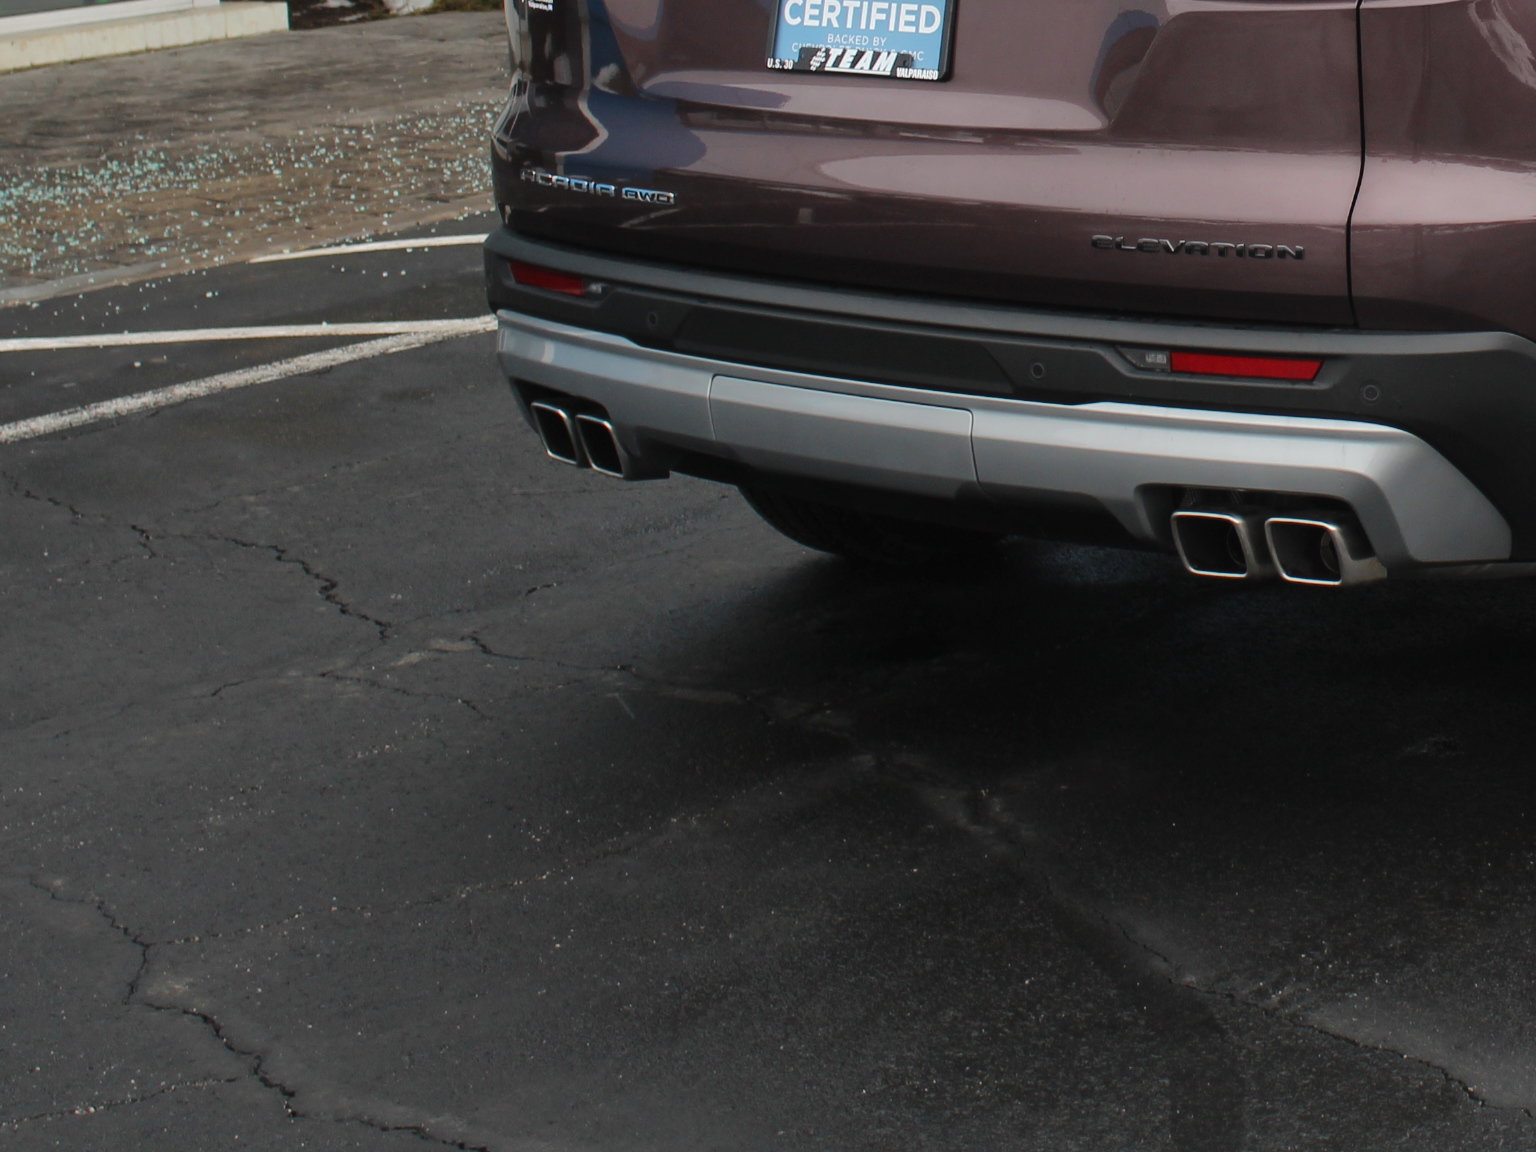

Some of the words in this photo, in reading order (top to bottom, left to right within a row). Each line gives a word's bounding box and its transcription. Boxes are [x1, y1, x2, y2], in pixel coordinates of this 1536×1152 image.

[827, 33, 869, 46] BACKED
[872, 36, 887, 47] BY
[767, 57, 782, 69] U.S.
[896, 67, 939, 81] VALPARAISO
[520, 167, 616, 198] ACADIA
[621, 186, 676, 205] AWD
[1091, 234, 1305, 260] ELEVATION
